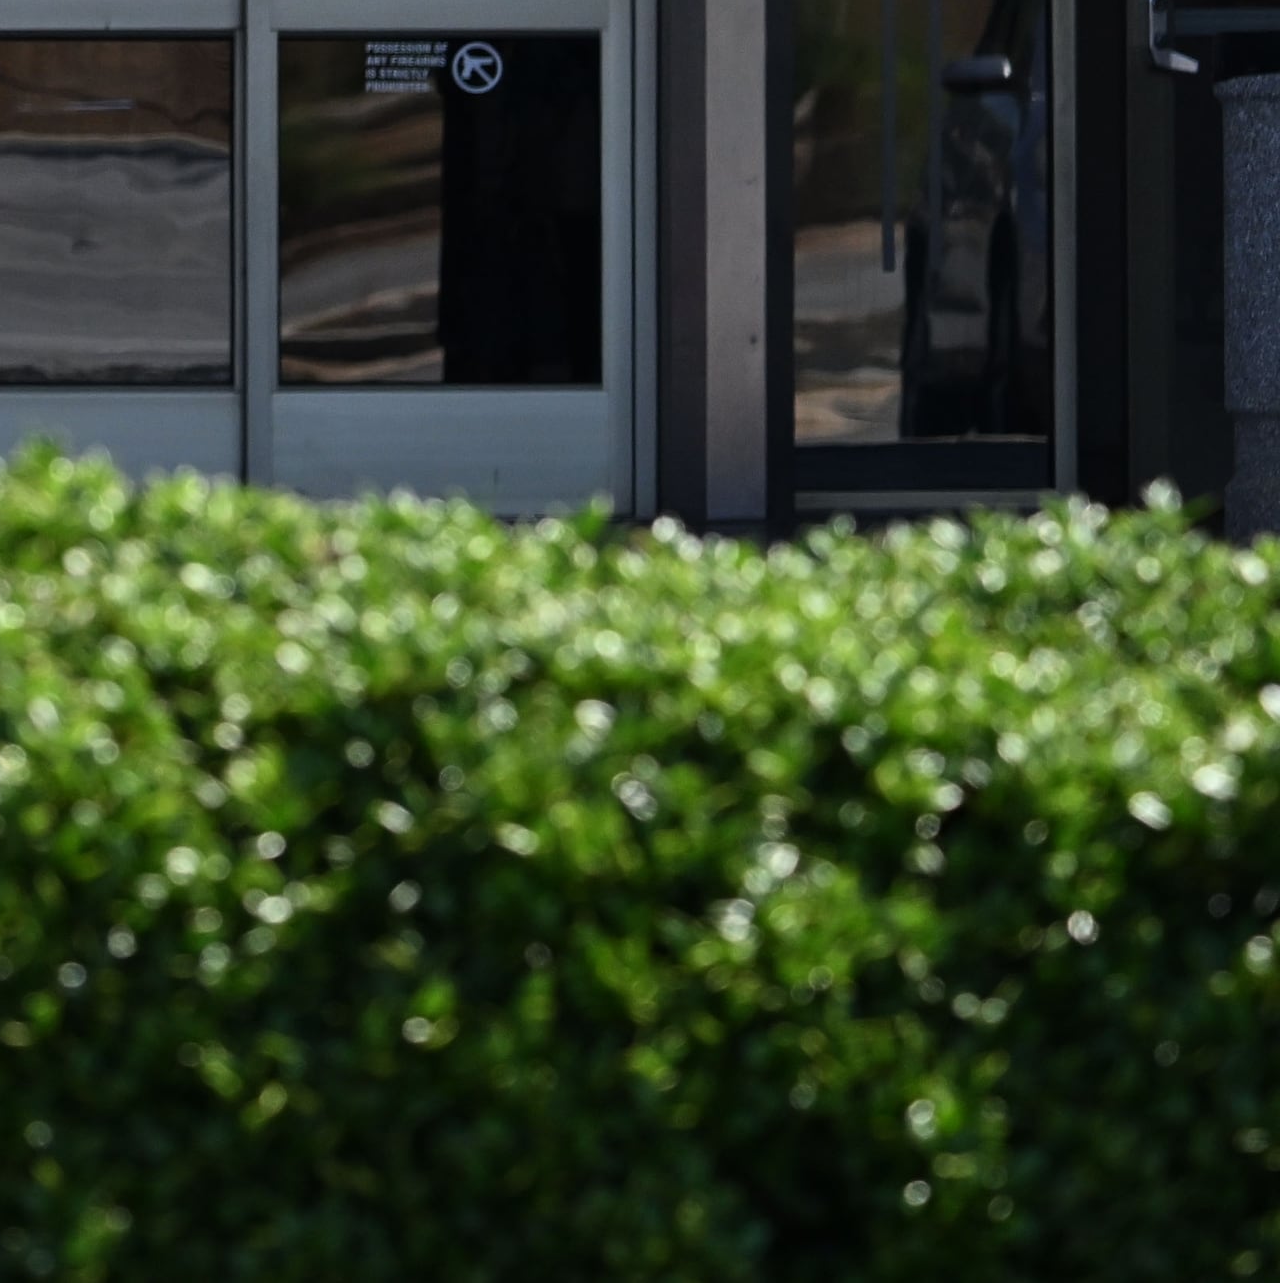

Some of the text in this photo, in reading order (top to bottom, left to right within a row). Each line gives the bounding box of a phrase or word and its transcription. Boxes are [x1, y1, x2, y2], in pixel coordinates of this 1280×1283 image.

[365, 41, 432, 54] POSSESSION
[365, 55, 447, 68] ANY FIREARMS
[365, 68, 429, 80] IS STRICTLY
